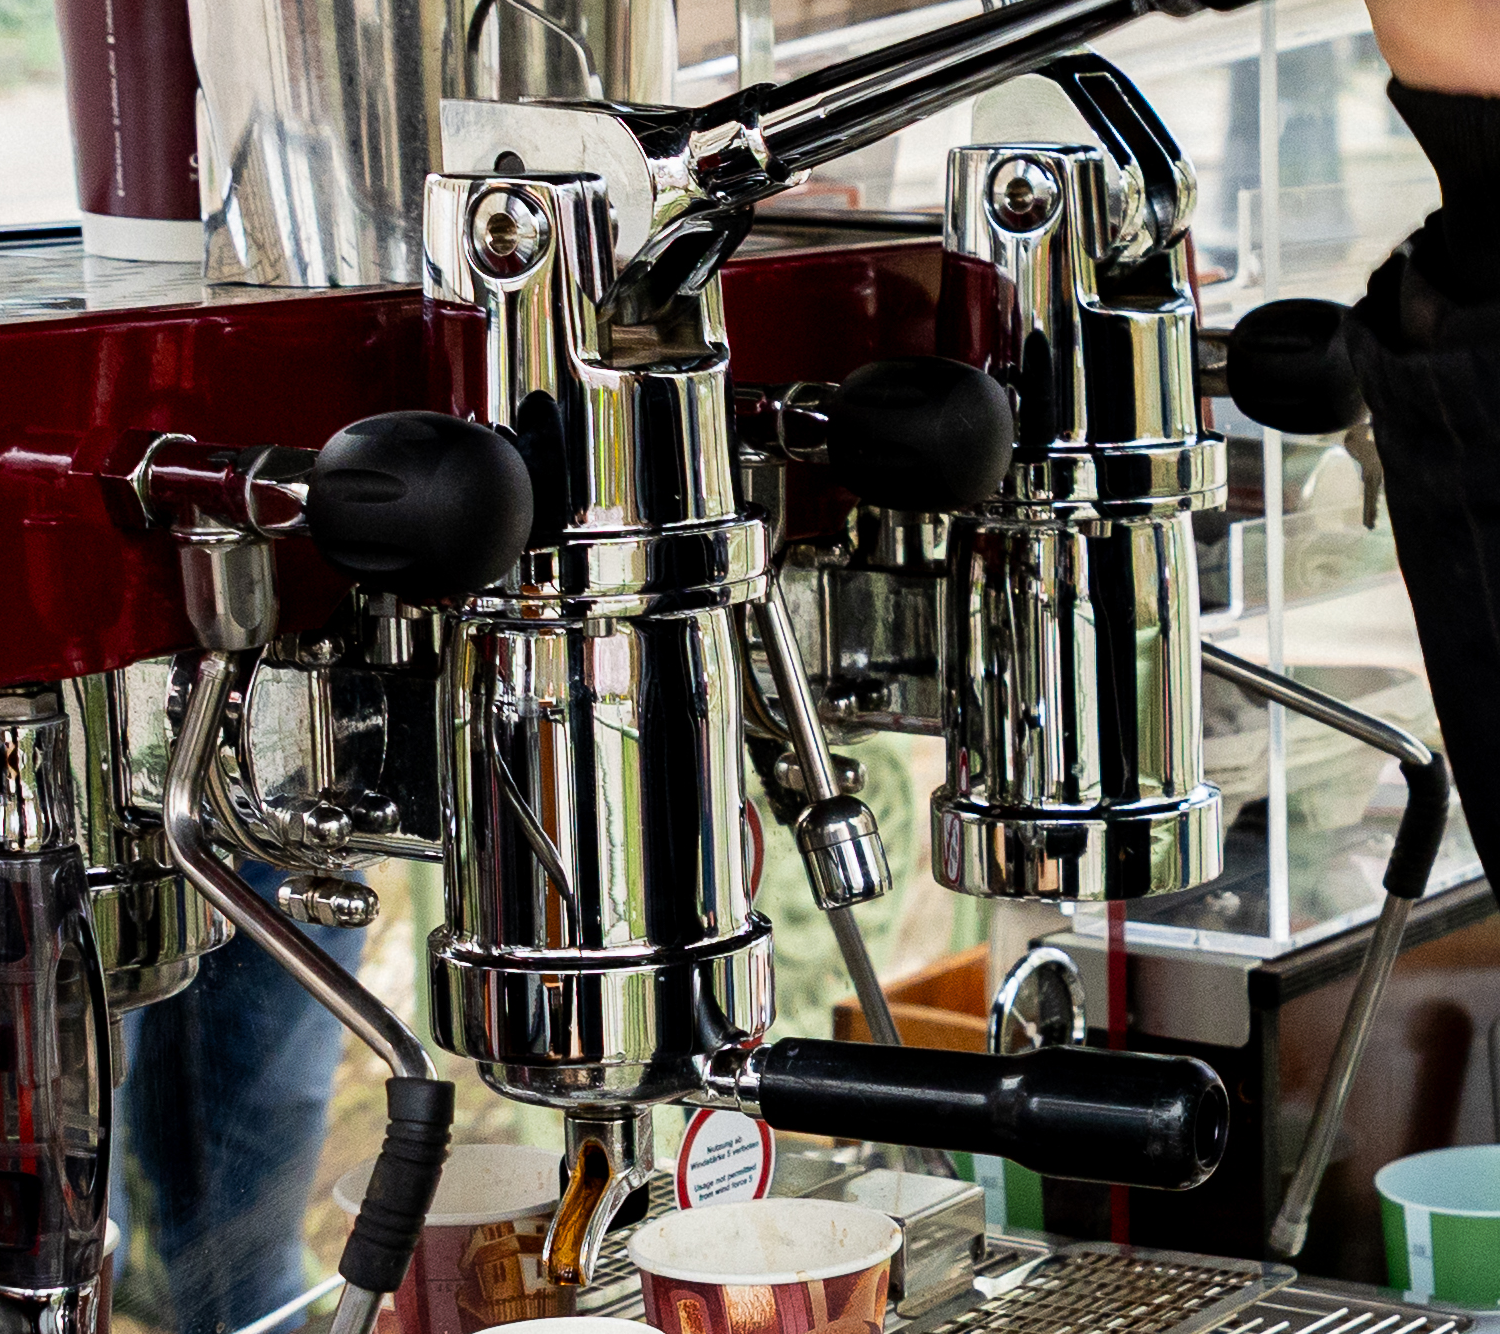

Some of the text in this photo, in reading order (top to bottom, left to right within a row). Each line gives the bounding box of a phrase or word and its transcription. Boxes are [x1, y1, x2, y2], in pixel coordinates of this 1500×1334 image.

[706, 1139, 733, 1154] Nutzung
[733, 1141, 759, 1155] verboten
[694, 1163, 757, 1192] Usage not permitted
[699, 1190, 714, 1201] from
[715, 1183, 730, 1195] wind
[731, 1178, 747, 1189] force
